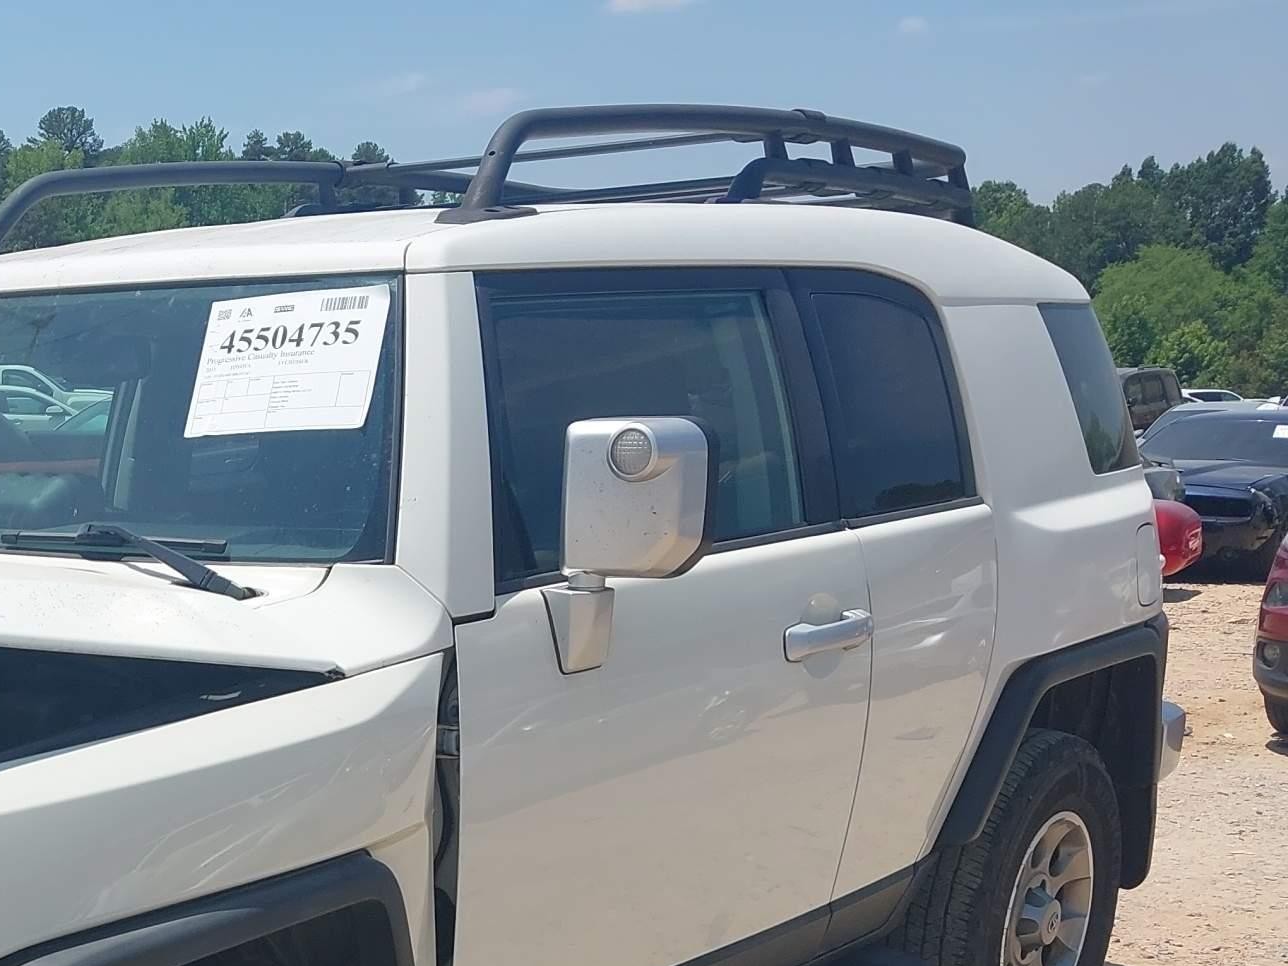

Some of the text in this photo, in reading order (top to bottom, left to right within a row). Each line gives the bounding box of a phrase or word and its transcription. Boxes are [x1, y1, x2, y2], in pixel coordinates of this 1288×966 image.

[220, 320, 361, 354] 45504735
[206, 349, 316, 366] Progressive Casualty Insurance
